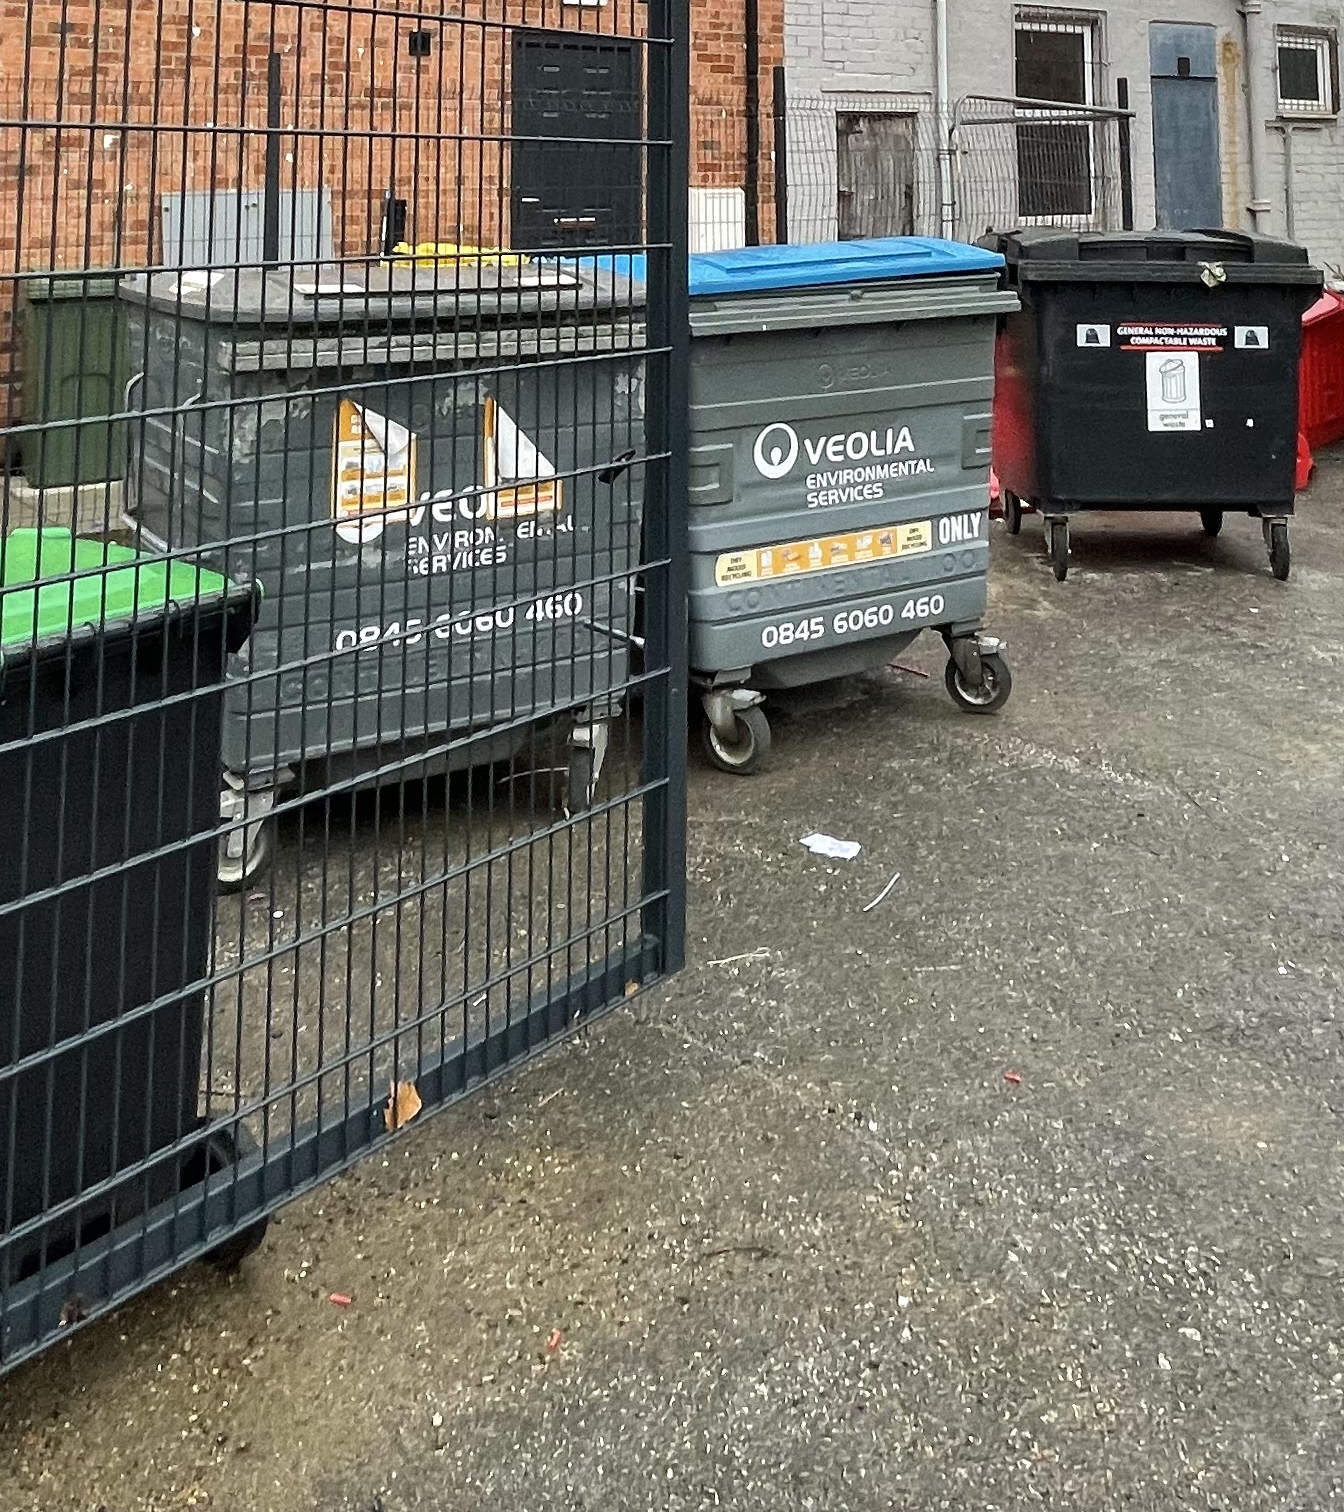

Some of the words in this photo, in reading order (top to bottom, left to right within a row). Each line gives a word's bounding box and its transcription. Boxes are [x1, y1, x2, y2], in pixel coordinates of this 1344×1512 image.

[1117, 326, 1154, 336] GENERAL
[1155, 327, 1228, 336] NON-HAZARDOUS
[1130, 336, 1187, 346] COMPACTABLE
[1188, 337, 1217, 346] WASTE
[1159, 411, 1189, 421] general
[803, 425, 916, 465] VEOLIA
[806, 458, 935, 490] ENVIRONMENTAL
[806, 482, 884, 508] SERVICES
[938, 511, 982, 545] ONLY
[336, 618, 423, 652] 0845
[524, 591, 583, 622] 460
[761, 616, 825, 648] 0845
[833, 604, 894, 635] 6060
[901, 595, 945, 620] 460
